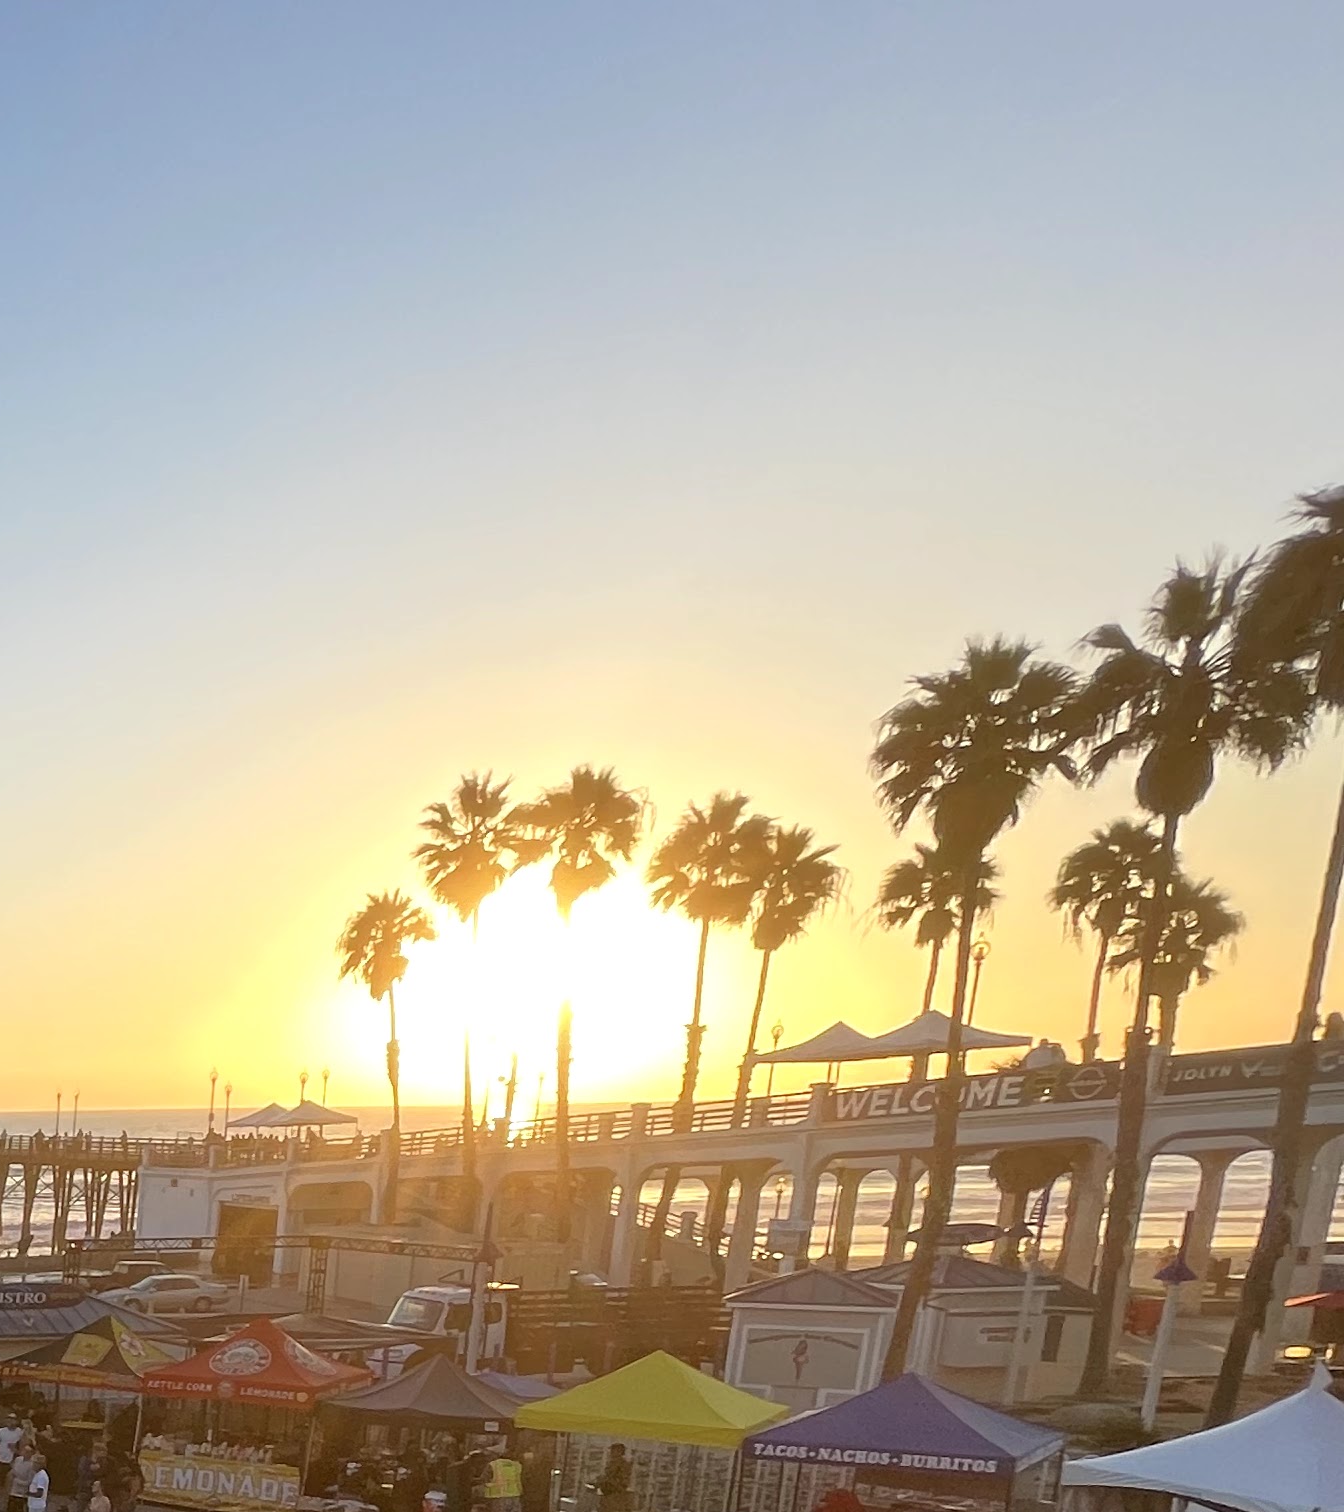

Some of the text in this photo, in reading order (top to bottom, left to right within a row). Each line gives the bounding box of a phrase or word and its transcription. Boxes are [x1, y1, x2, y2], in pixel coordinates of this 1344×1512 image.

[835, 1076, 1027, 1119] WELCME
[147, 1379, 213, 1392] KETTLE CORN
[240, 1387, 296, 1400] LEMONADE
[754, 1443, 998, 1473] TACOS NACHOS BURRITOS
